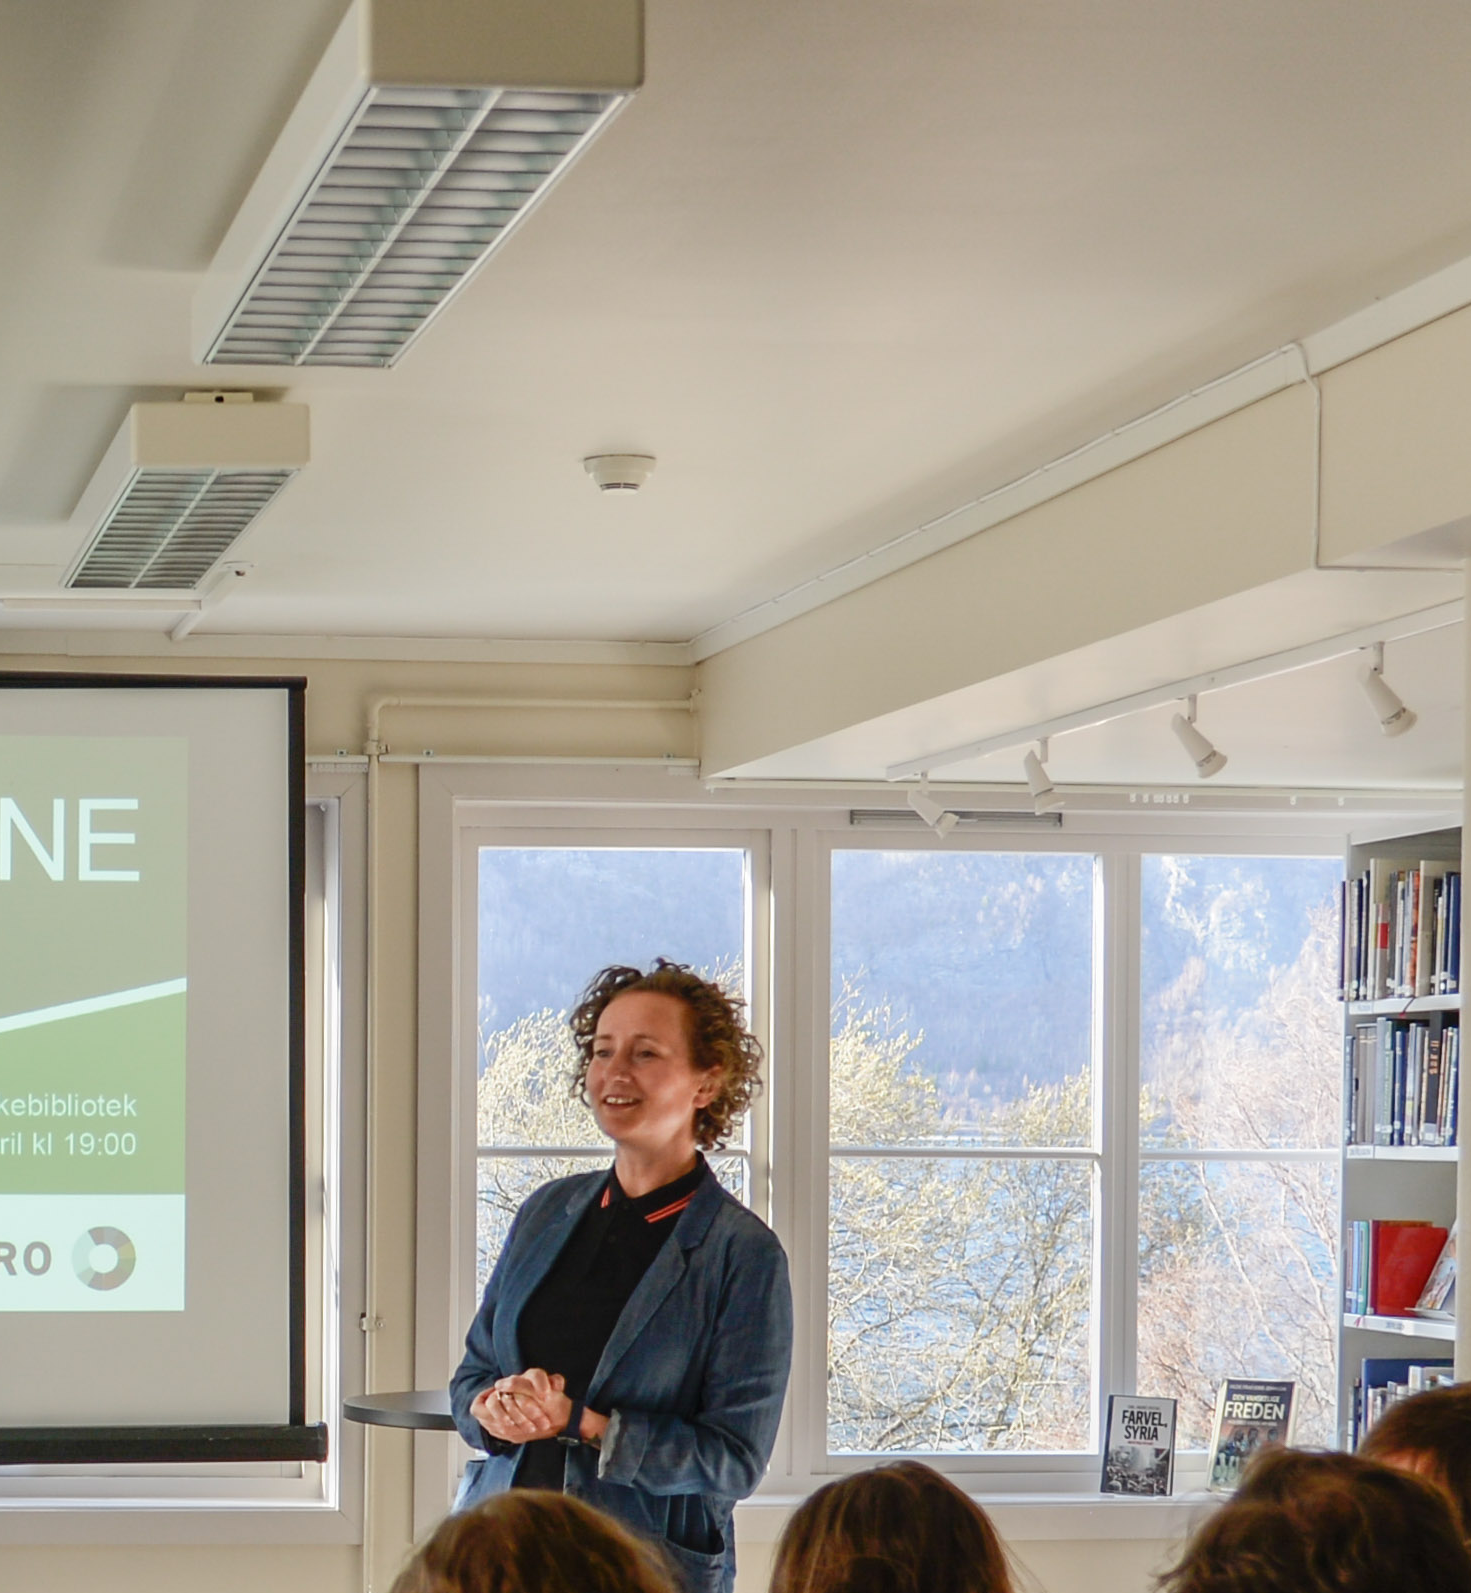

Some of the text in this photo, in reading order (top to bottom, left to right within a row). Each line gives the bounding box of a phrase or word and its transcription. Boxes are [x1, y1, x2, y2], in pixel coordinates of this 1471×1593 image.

[32, 1131, 53, 1155] kl
[64, 1131, 137, 1156] 19:00
[1121, 1409, 1168, 1428] FARVEL,
[1224, 1401, 1286, 1421] FREDEN
[1124, 1425, 1159, 1441] SYRIA
